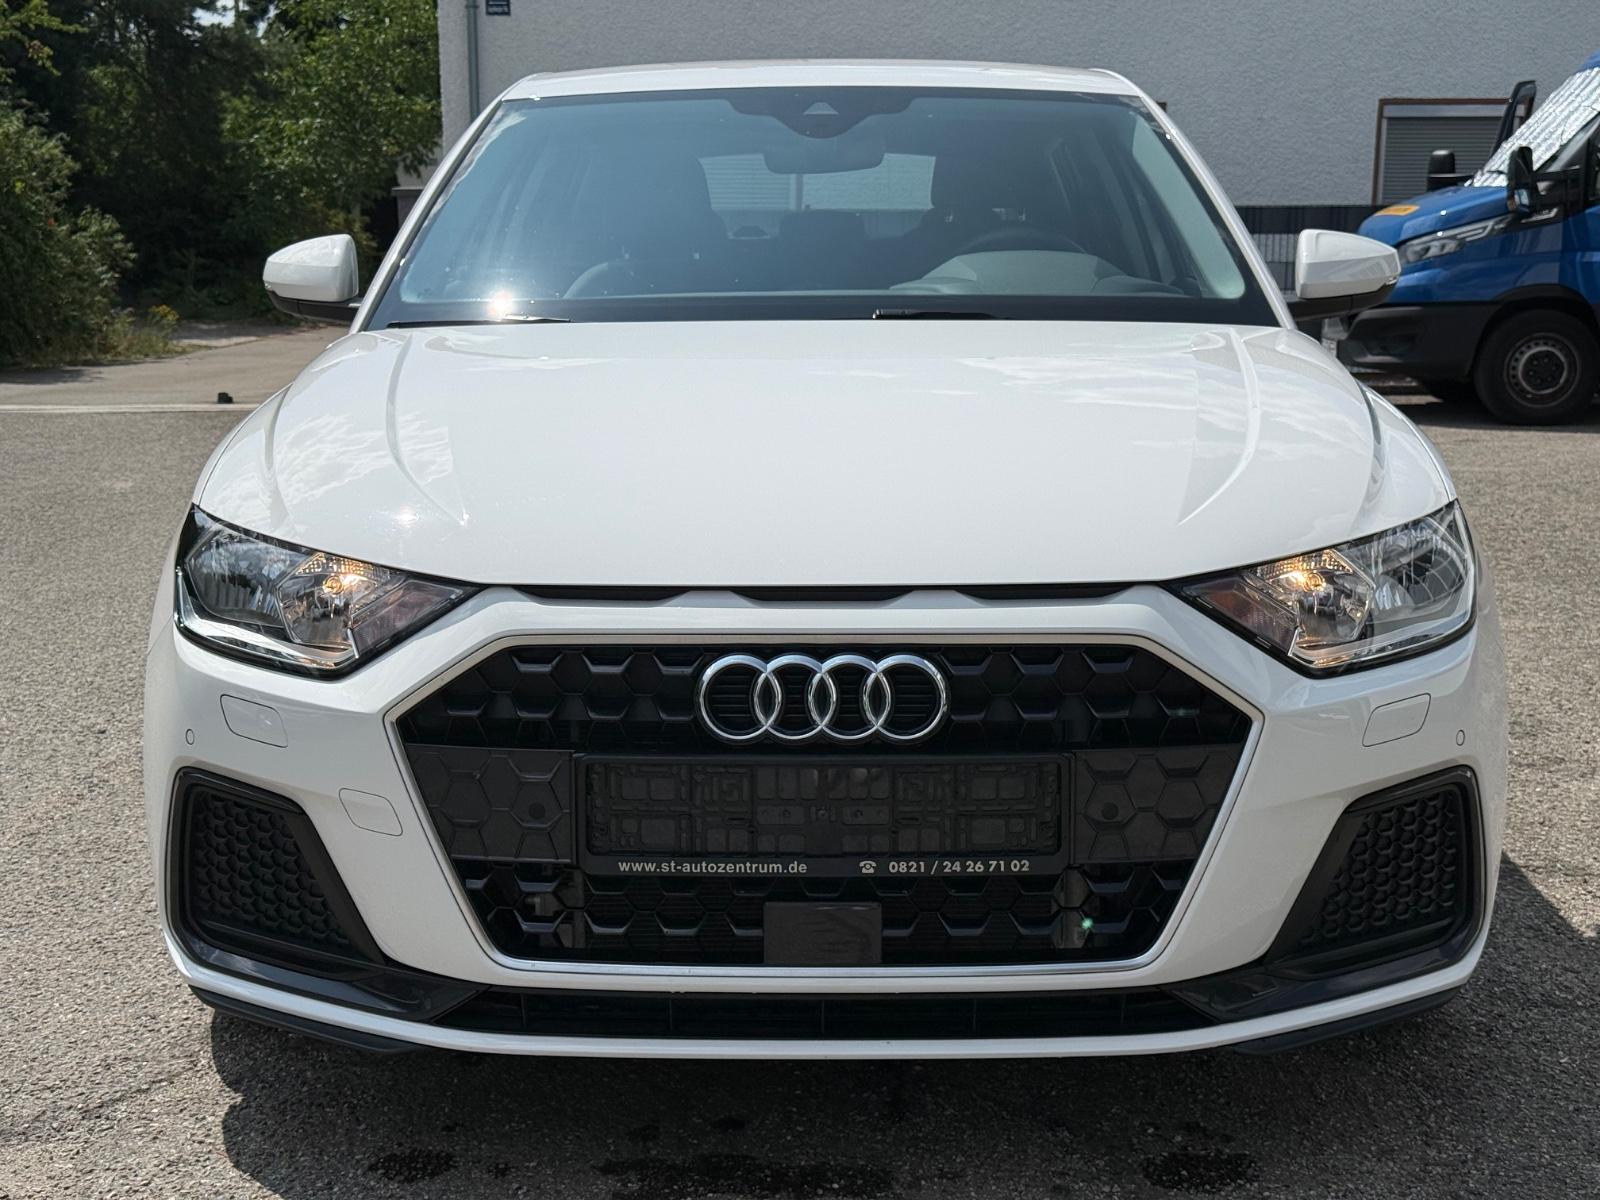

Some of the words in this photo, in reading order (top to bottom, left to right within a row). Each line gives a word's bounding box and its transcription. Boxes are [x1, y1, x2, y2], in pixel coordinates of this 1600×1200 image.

[617, 860, 808, 873] www.st-autozentrum.de
[888, 861, 925, 874] 0821
[930, 860, 938, 875] /
[942, 860, 962, 873] 24
[965, 860, 985, 873] 26
[988, 860, 1005, 872] 71
[1010, 859, 1030, 872] 02
